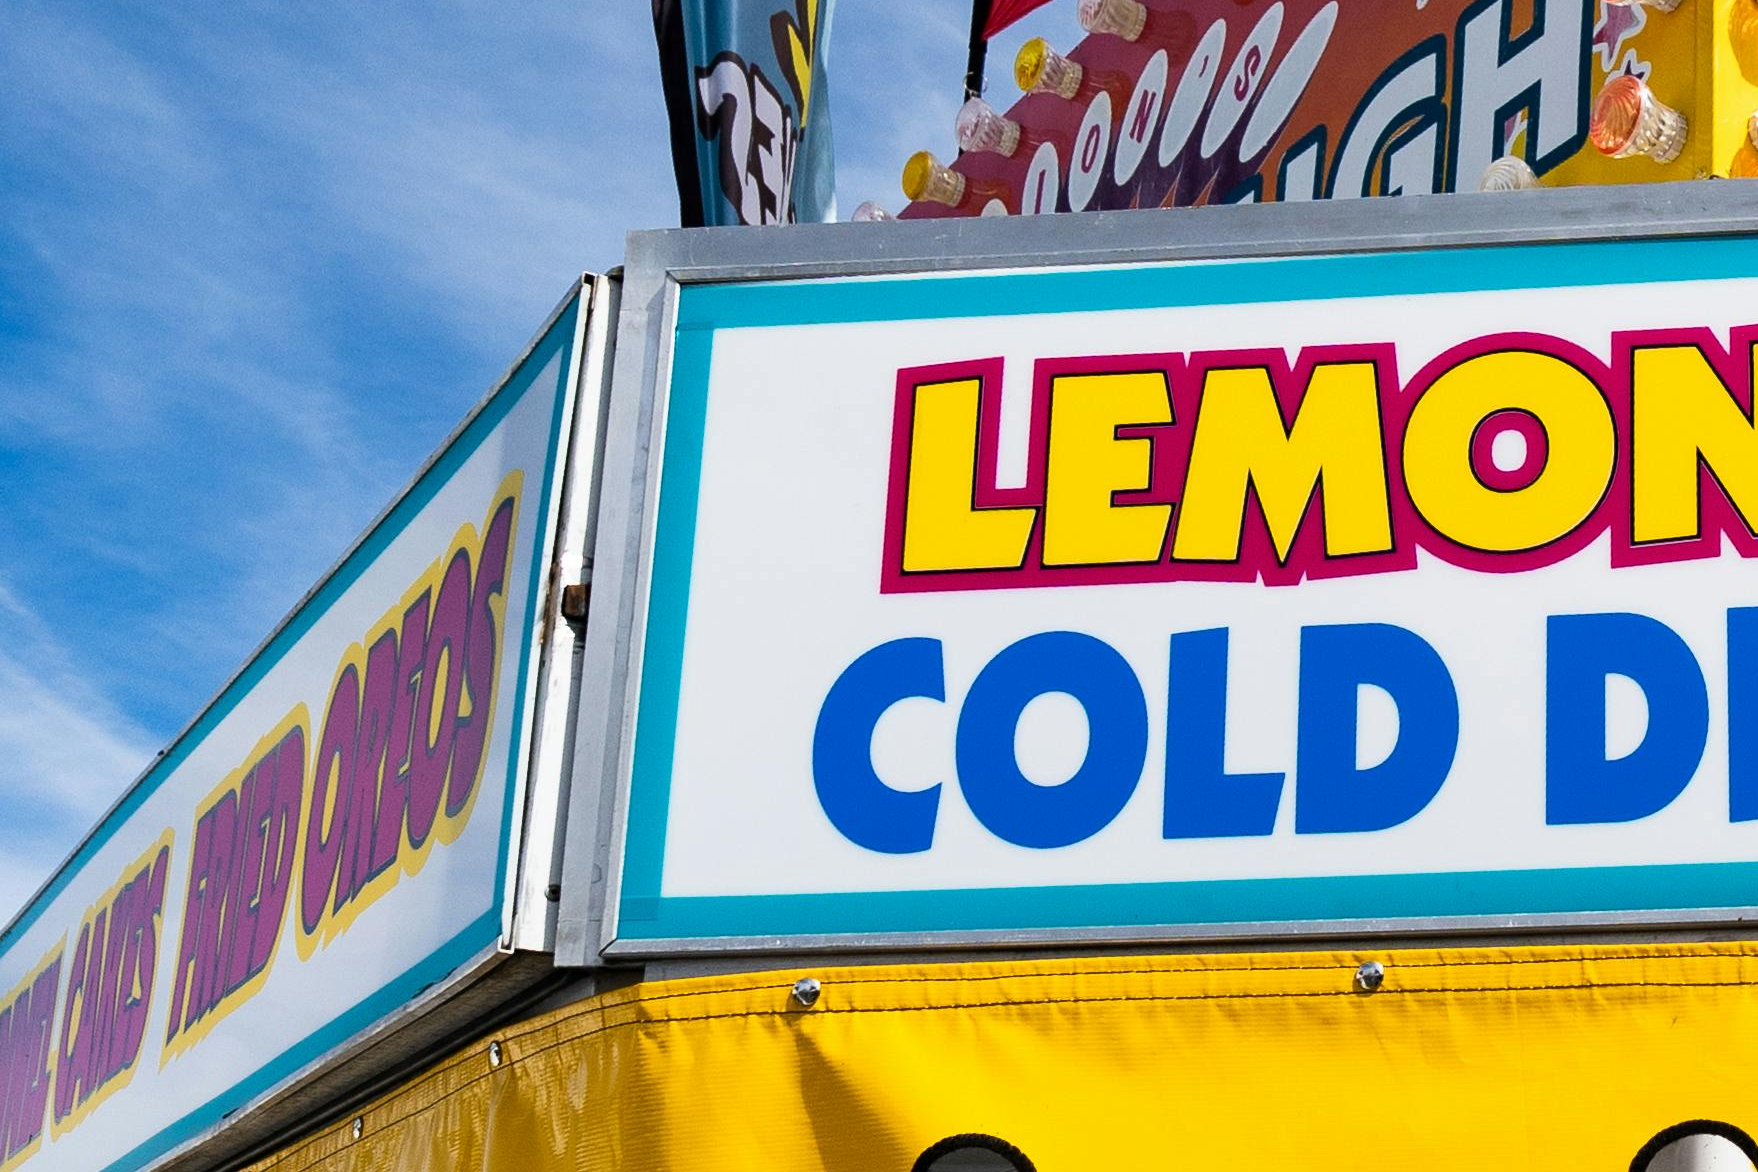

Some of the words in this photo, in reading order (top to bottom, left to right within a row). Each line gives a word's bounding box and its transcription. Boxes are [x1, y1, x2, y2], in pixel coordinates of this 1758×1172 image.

[53, 843, 169, 1126] CAKES
[166, 724, 306, 1047] FRIED
[301, 496, 516, 936] OREOS
[812, 622, 1460, 855] COLD
